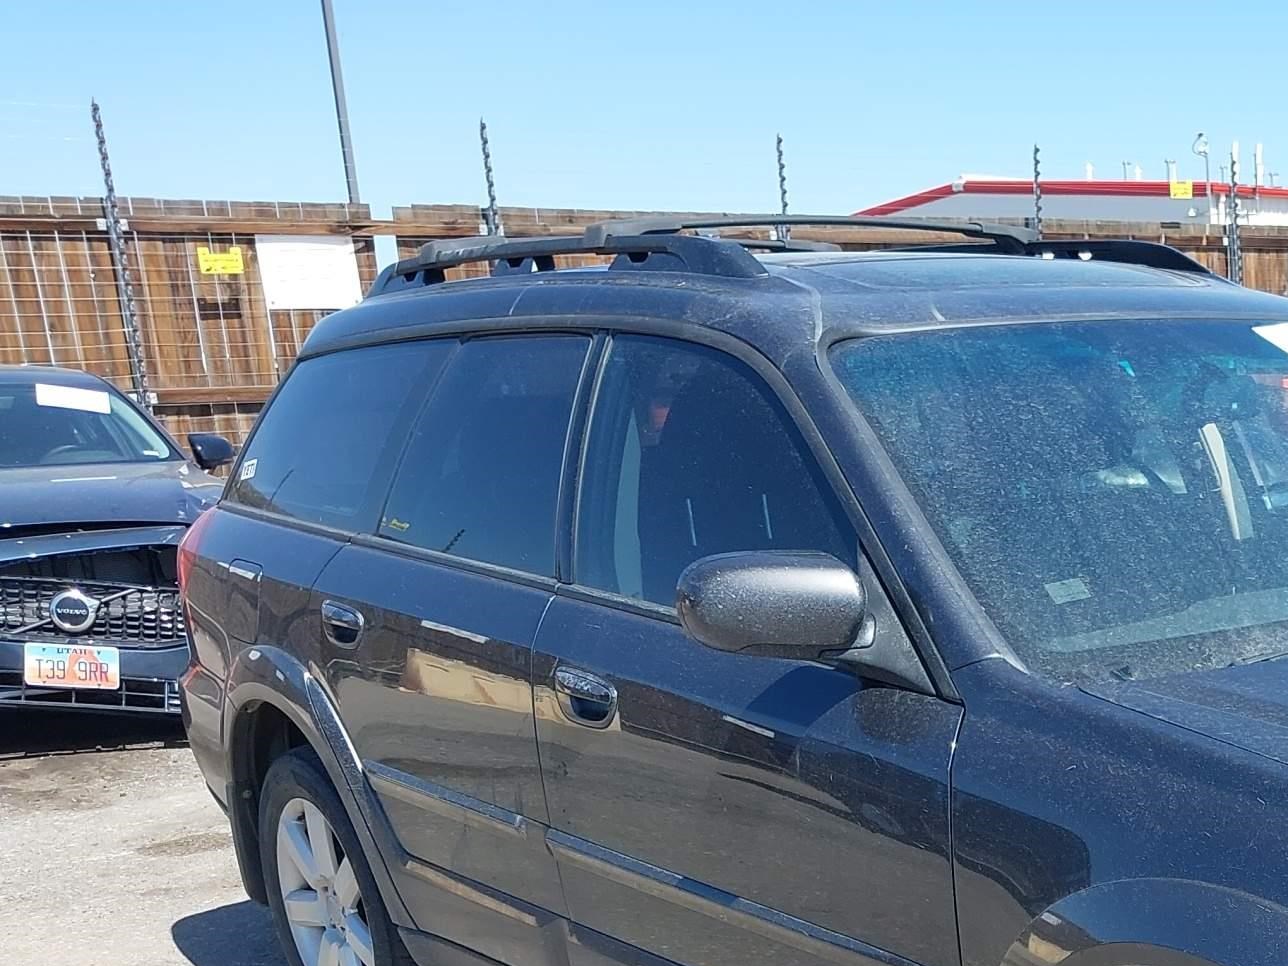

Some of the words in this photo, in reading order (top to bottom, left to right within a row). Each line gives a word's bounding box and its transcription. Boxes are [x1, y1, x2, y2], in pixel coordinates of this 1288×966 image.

[56, 607, 88, 616] VOLVO
[56, 647, 88, 656] UTAH
[78, 660, 109, 683] 9RR
